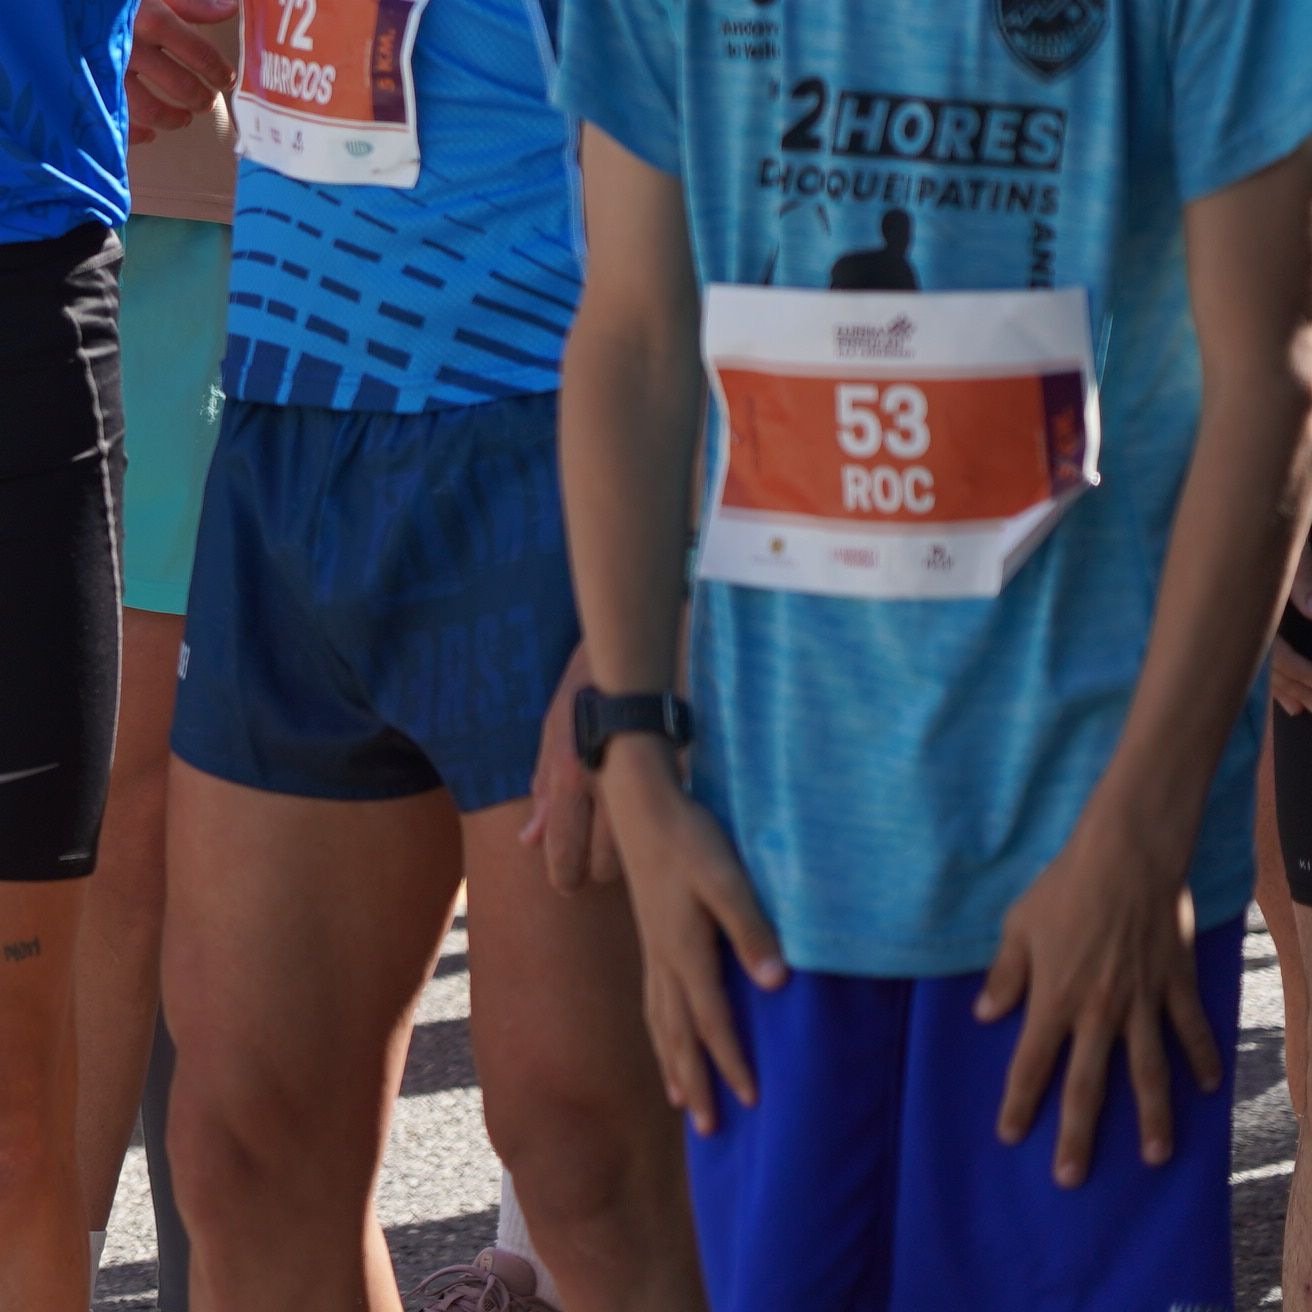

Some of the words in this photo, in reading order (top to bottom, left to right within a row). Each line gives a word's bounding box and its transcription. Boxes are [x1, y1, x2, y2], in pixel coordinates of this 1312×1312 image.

[261, 51, 336, 104] MARCOS
[834, 383, 930, 459] 53
[841, 463, 935, 514] ROC
